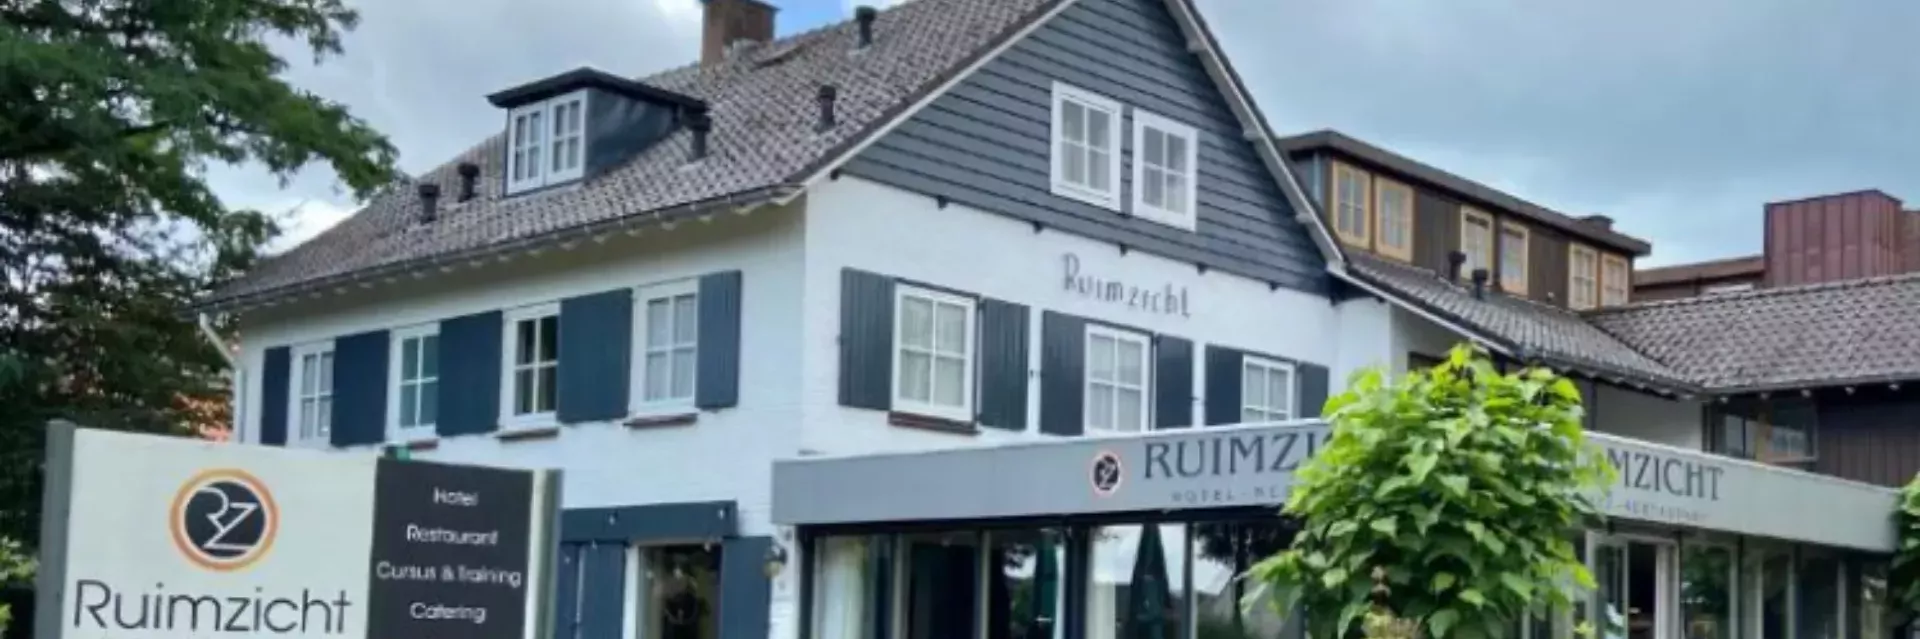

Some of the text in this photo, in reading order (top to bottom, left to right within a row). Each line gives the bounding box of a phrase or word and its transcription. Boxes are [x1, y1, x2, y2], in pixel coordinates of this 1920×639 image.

[1062, 251, 1191, 319] Ruimzicht
[1143, 431, 1333, 480] RUIMZI
[1601, 447, 1724, 502] MZICHT
[432, 485, 480, 506] Hotel
[406, 522, 499, 546] Restaurant
[376, 560, 522, 588] Cursus & Training
[73, 578, 353, 634] Ruimzicht
[409, 601, 487, 624] Catering
